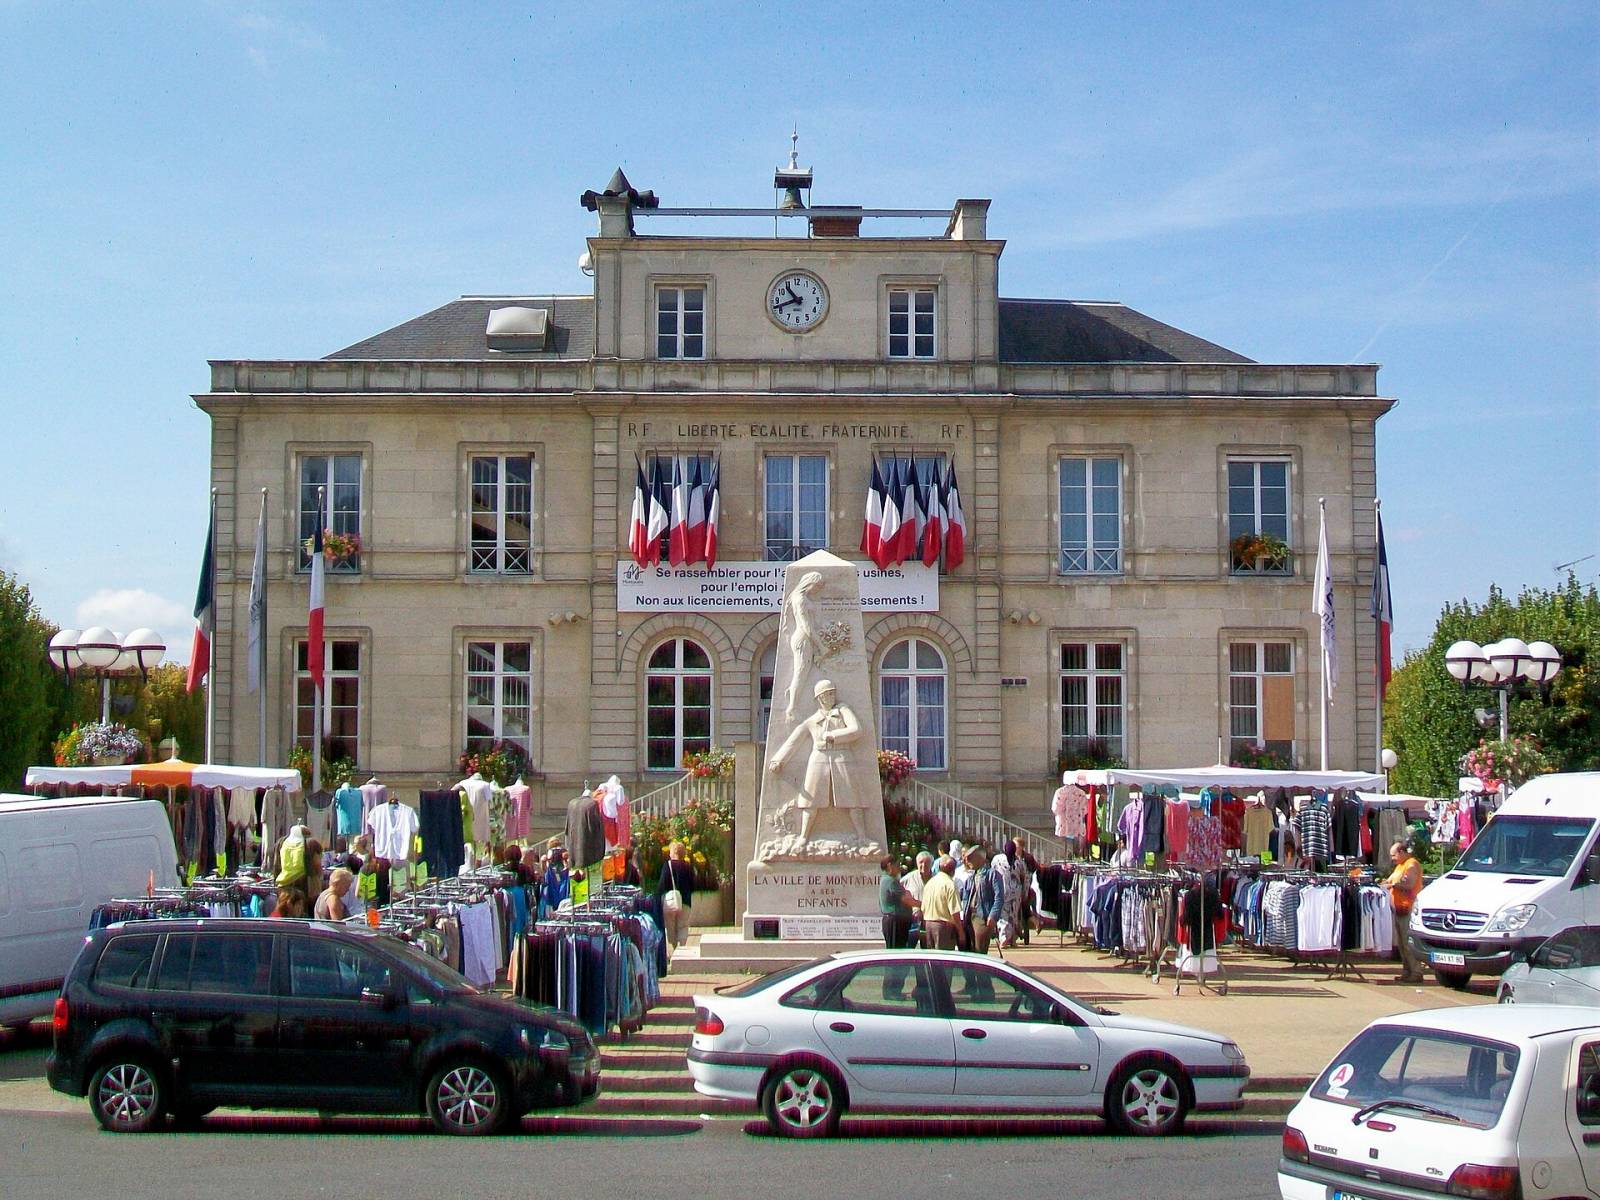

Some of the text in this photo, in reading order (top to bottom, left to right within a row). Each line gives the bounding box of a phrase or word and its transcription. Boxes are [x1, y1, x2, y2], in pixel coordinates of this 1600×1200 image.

[794, 278, 801, 286] 12
[778, 288, 786, 296] 10
[795, 316, 800, 324] 6
[804, 313, 810, 321] 5
[656, 568, 671, 578] Se
[675, 568, 741, 578] rassembler
[744, 570, 772, 581] pour
[863, 569, 905, 579] usines,
[701, 585, 731, 594] pour
[731, 582, 778, 594] l'emploi
[636, 596, 660, 606] Non
[663, 598, 684, 606] aux
[687, 596, 774, 608] licenciements,
[754, 875, 768, 886] LA
[773, 875, 804, 886] VILLE
[808, 875, 821, 886] DE
[820, 888, 835, 896] SES
[797, 898, 848, 908] ENFANTS
[1332, 1065, 1348, 1082] A
